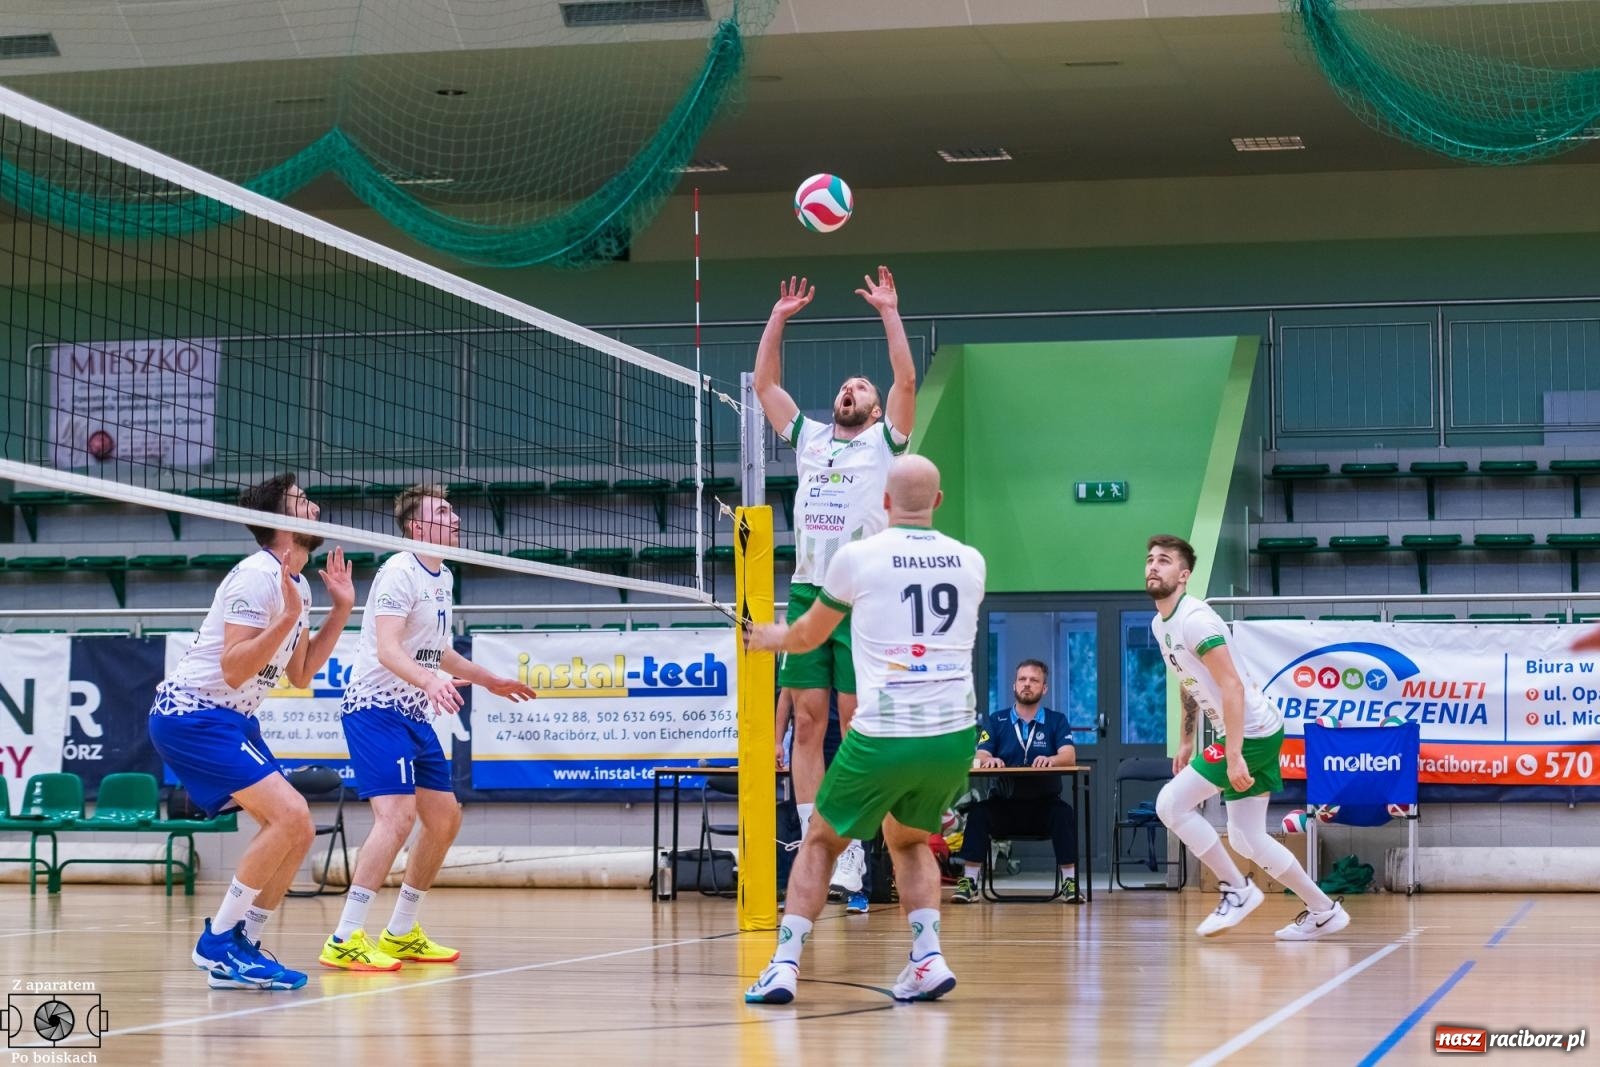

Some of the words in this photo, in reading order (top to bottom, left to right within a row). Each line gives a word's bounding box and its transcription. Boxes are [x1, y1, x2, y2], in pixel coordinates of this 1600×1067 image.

[70, 347, 199, 376] MIESZKO
[805, 514, 845, 526] PIVEXIN
[892, 555, 962, 569] BIAŁUSKI
[900, 582, 959, 636] 19
[884, 646, 908, 657] radio
[518, 652, 727, 695] instal-tech
[1526, 658, 1574, 674] Biura
[1580, 662, 1595, 673] w
[1401, 681, 1487, 699] MULTI
[1543, 685, 1567, 701] ul.
[283, 711, 304, 722] 502
[308, 711, 329, 722] 632
[487, 712, 506, 723] tel.
[509, 712, 523, 723] 32
[527, 712, 550, 723] 414
[554, 712, 568, 723] 92
[597, 711, 619, 723] 502
[623, 711, 645, 722] 632
[682, 710, 706, 721] 606
[710, 710, 732, 721] 363
[1543, 710, 1567, 725] ul.
[317, 730, 338, 739] von
[496, 730, 540, 741] 47-400
[603, 728, 617, 740] ul.
[621, 728, 630, 740] J.
[633, 730, 656, 740] von
[0, 746, 33, 778] Y
[1324, 753, 1400, 772] molten
[1417, 755, 1508, 778] raciborz.pl
[1545, 751, 1593, 778] 570
